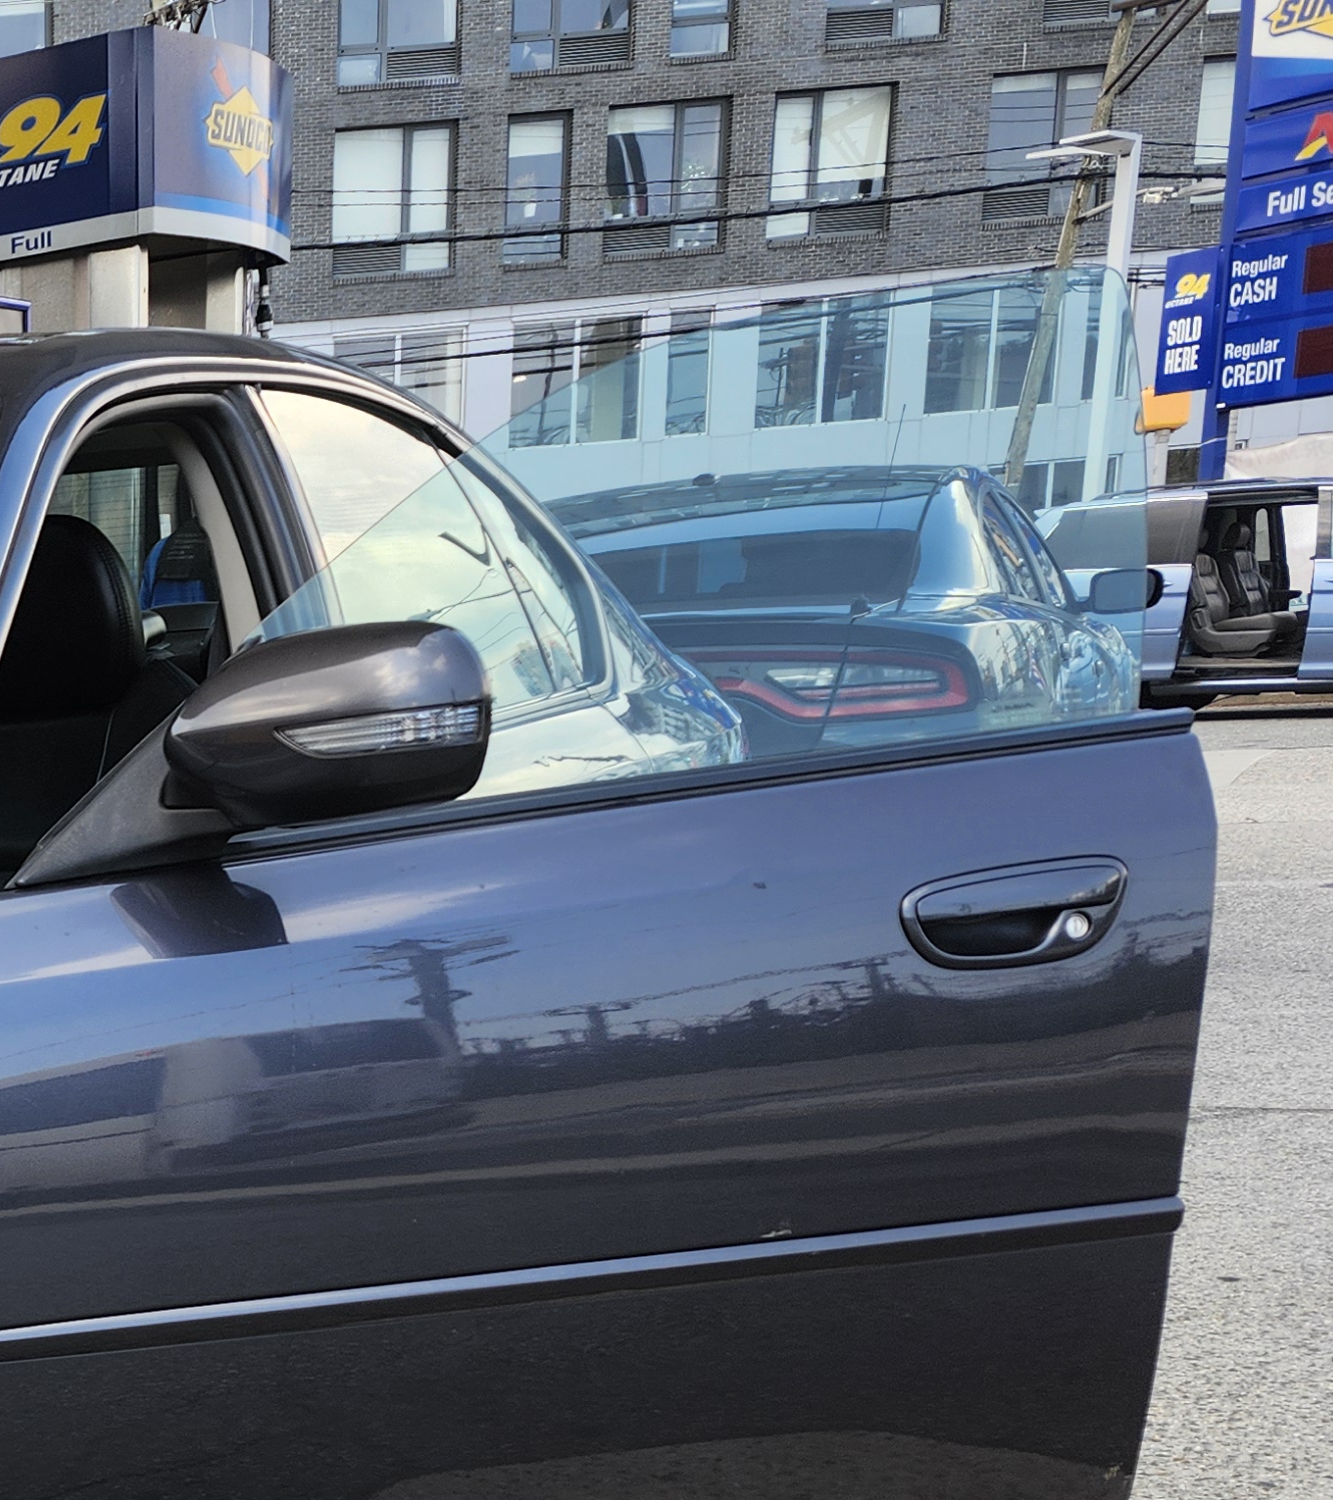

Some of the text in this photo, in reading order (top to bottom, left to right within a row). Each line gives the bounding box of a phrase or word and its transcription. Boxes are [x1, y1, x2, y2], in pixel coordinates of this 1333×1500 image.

[210, 108, 272, 155] SUNOCO
[1267, 185, 1307, 217] Full
[11, 230, 52, 254] Full
[1232, 254, 1288, 278] Regular
[1175, 272, 1211, 300] 94
[1229, 276, 1278, 307] CASH
[1167, 315, 1203, 346] SOLD
[1164, 344, 1200, 375] HERE
[1224, 338, 1280, 361] Regular
[1221, 357, 1286, 388] CREDIT
